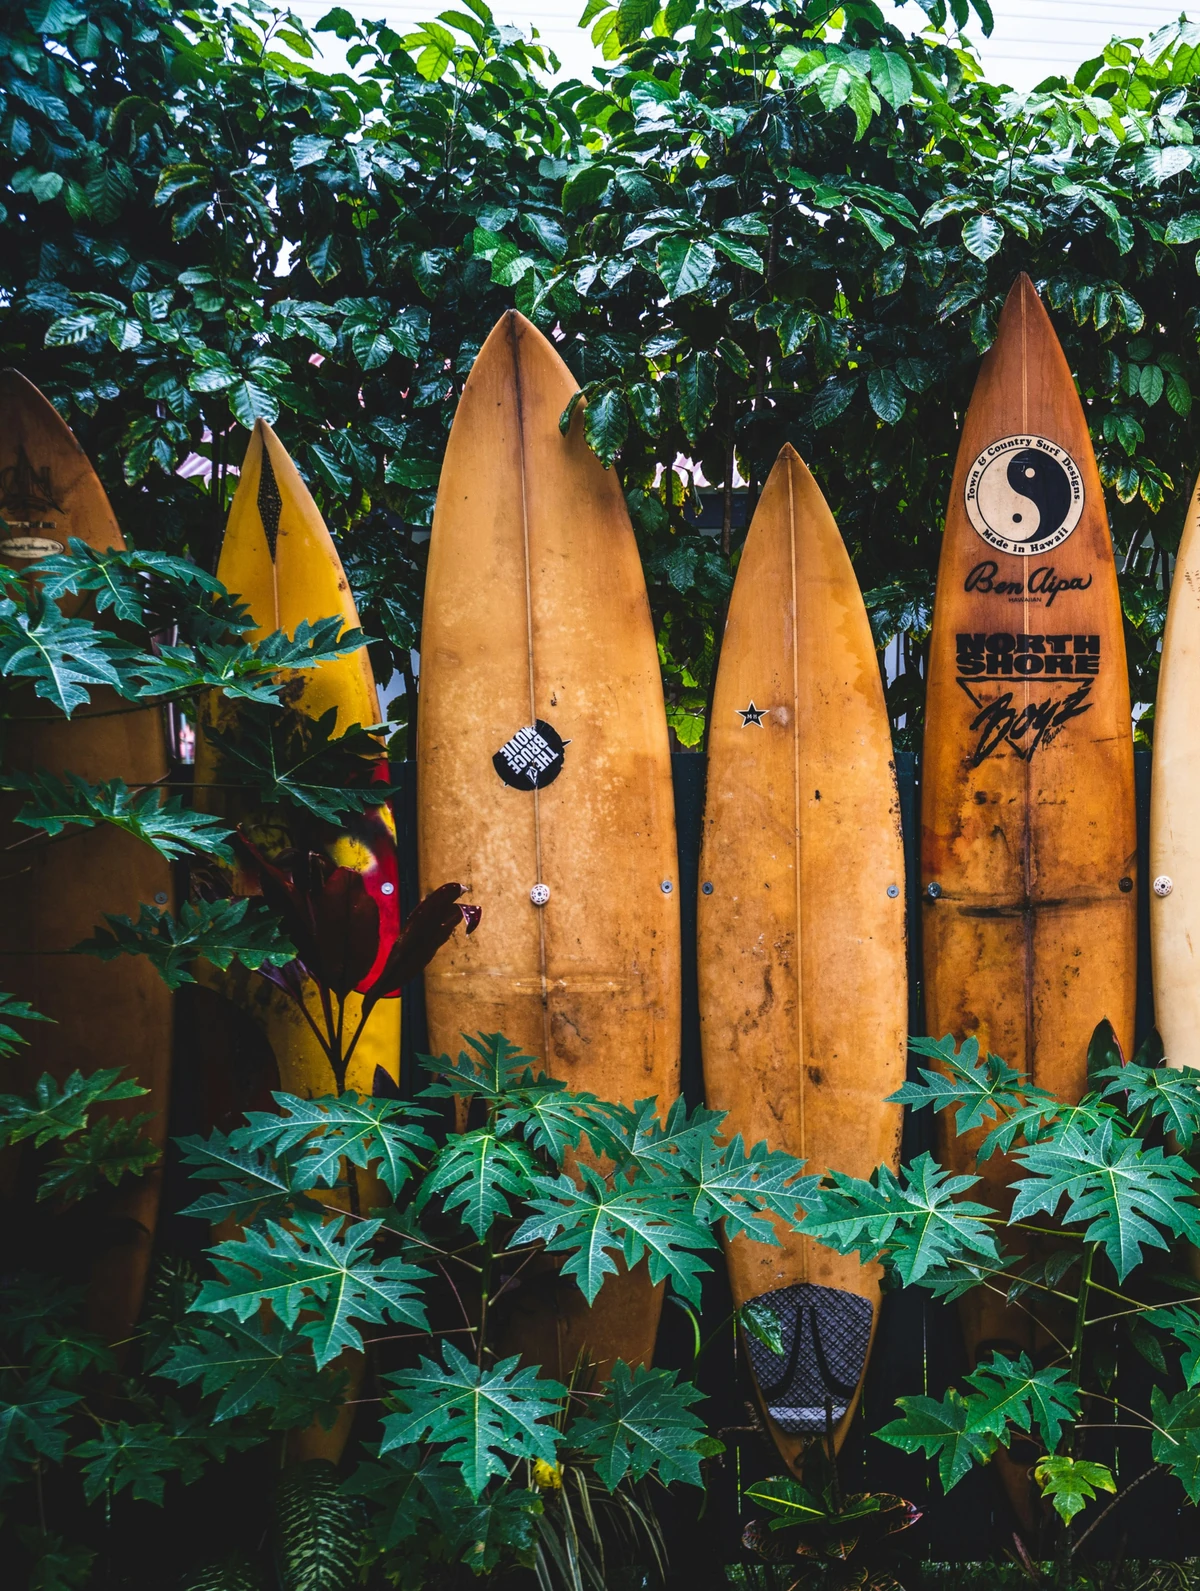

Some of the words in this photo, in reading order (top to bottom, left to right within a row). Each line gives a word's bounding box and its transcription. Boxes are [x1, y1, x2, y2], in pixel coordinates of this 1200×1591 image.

[967, 471, 979, 501] Town
[978, 456, 987, 466] &
[988, 438, 1032, 456] Country
[1036, 440, 1060, 457] Surf
[1062, 457, 1081, 500] Designs
[982, 529, 1009, 549] Made
[1013, 544, 1025, 553] in
[1030, 527, 1069, 552] Hawaii
[964, 561, 1024, 595] Ben
[1027, 567, 1092, 607] Aipa
[956, 632, 1100, 654] NORTH
[956, 654, 1100, 675] SHORE
[500, 725, 537, 761] MOVIE
[969, 687, 1094, 767] Boyz
[508, 734, 548, 774] BRUCE
[533, 746, 559, 772] THE
